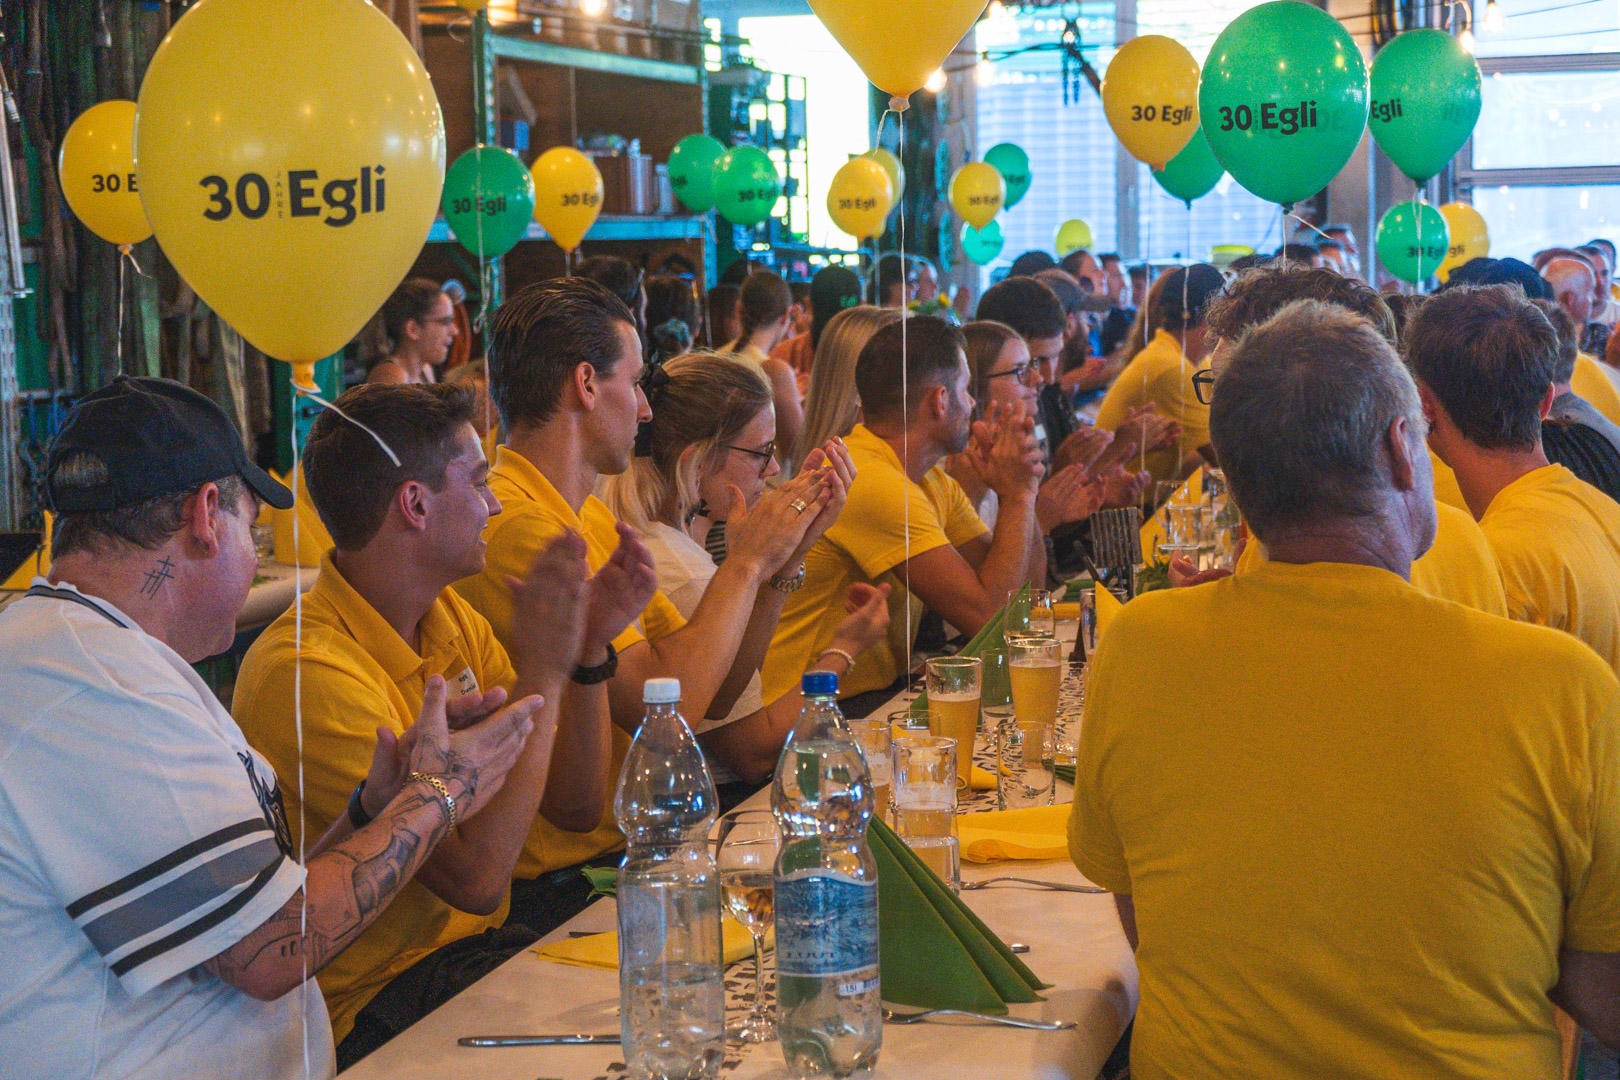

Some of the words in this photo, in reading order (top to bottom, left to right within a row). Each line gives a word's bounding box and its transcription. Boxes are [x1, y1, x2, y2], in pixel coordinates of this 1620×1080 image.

[1131, 105, 1156, 122] 30
[1162, 105, 1193, 125] Egli
[1218, 104, 1252, 131] 30
[1261, 100, 1317, 135] Egli
[1371, 98, 1402, 123] Egli
[92, 173, 121, 193] 30
[200, 173, 271, 221] 30
[288, 164, 386, 228] Egli
[452, 197, 471, 215] 30
[475, 194, 507, 217] Egli
